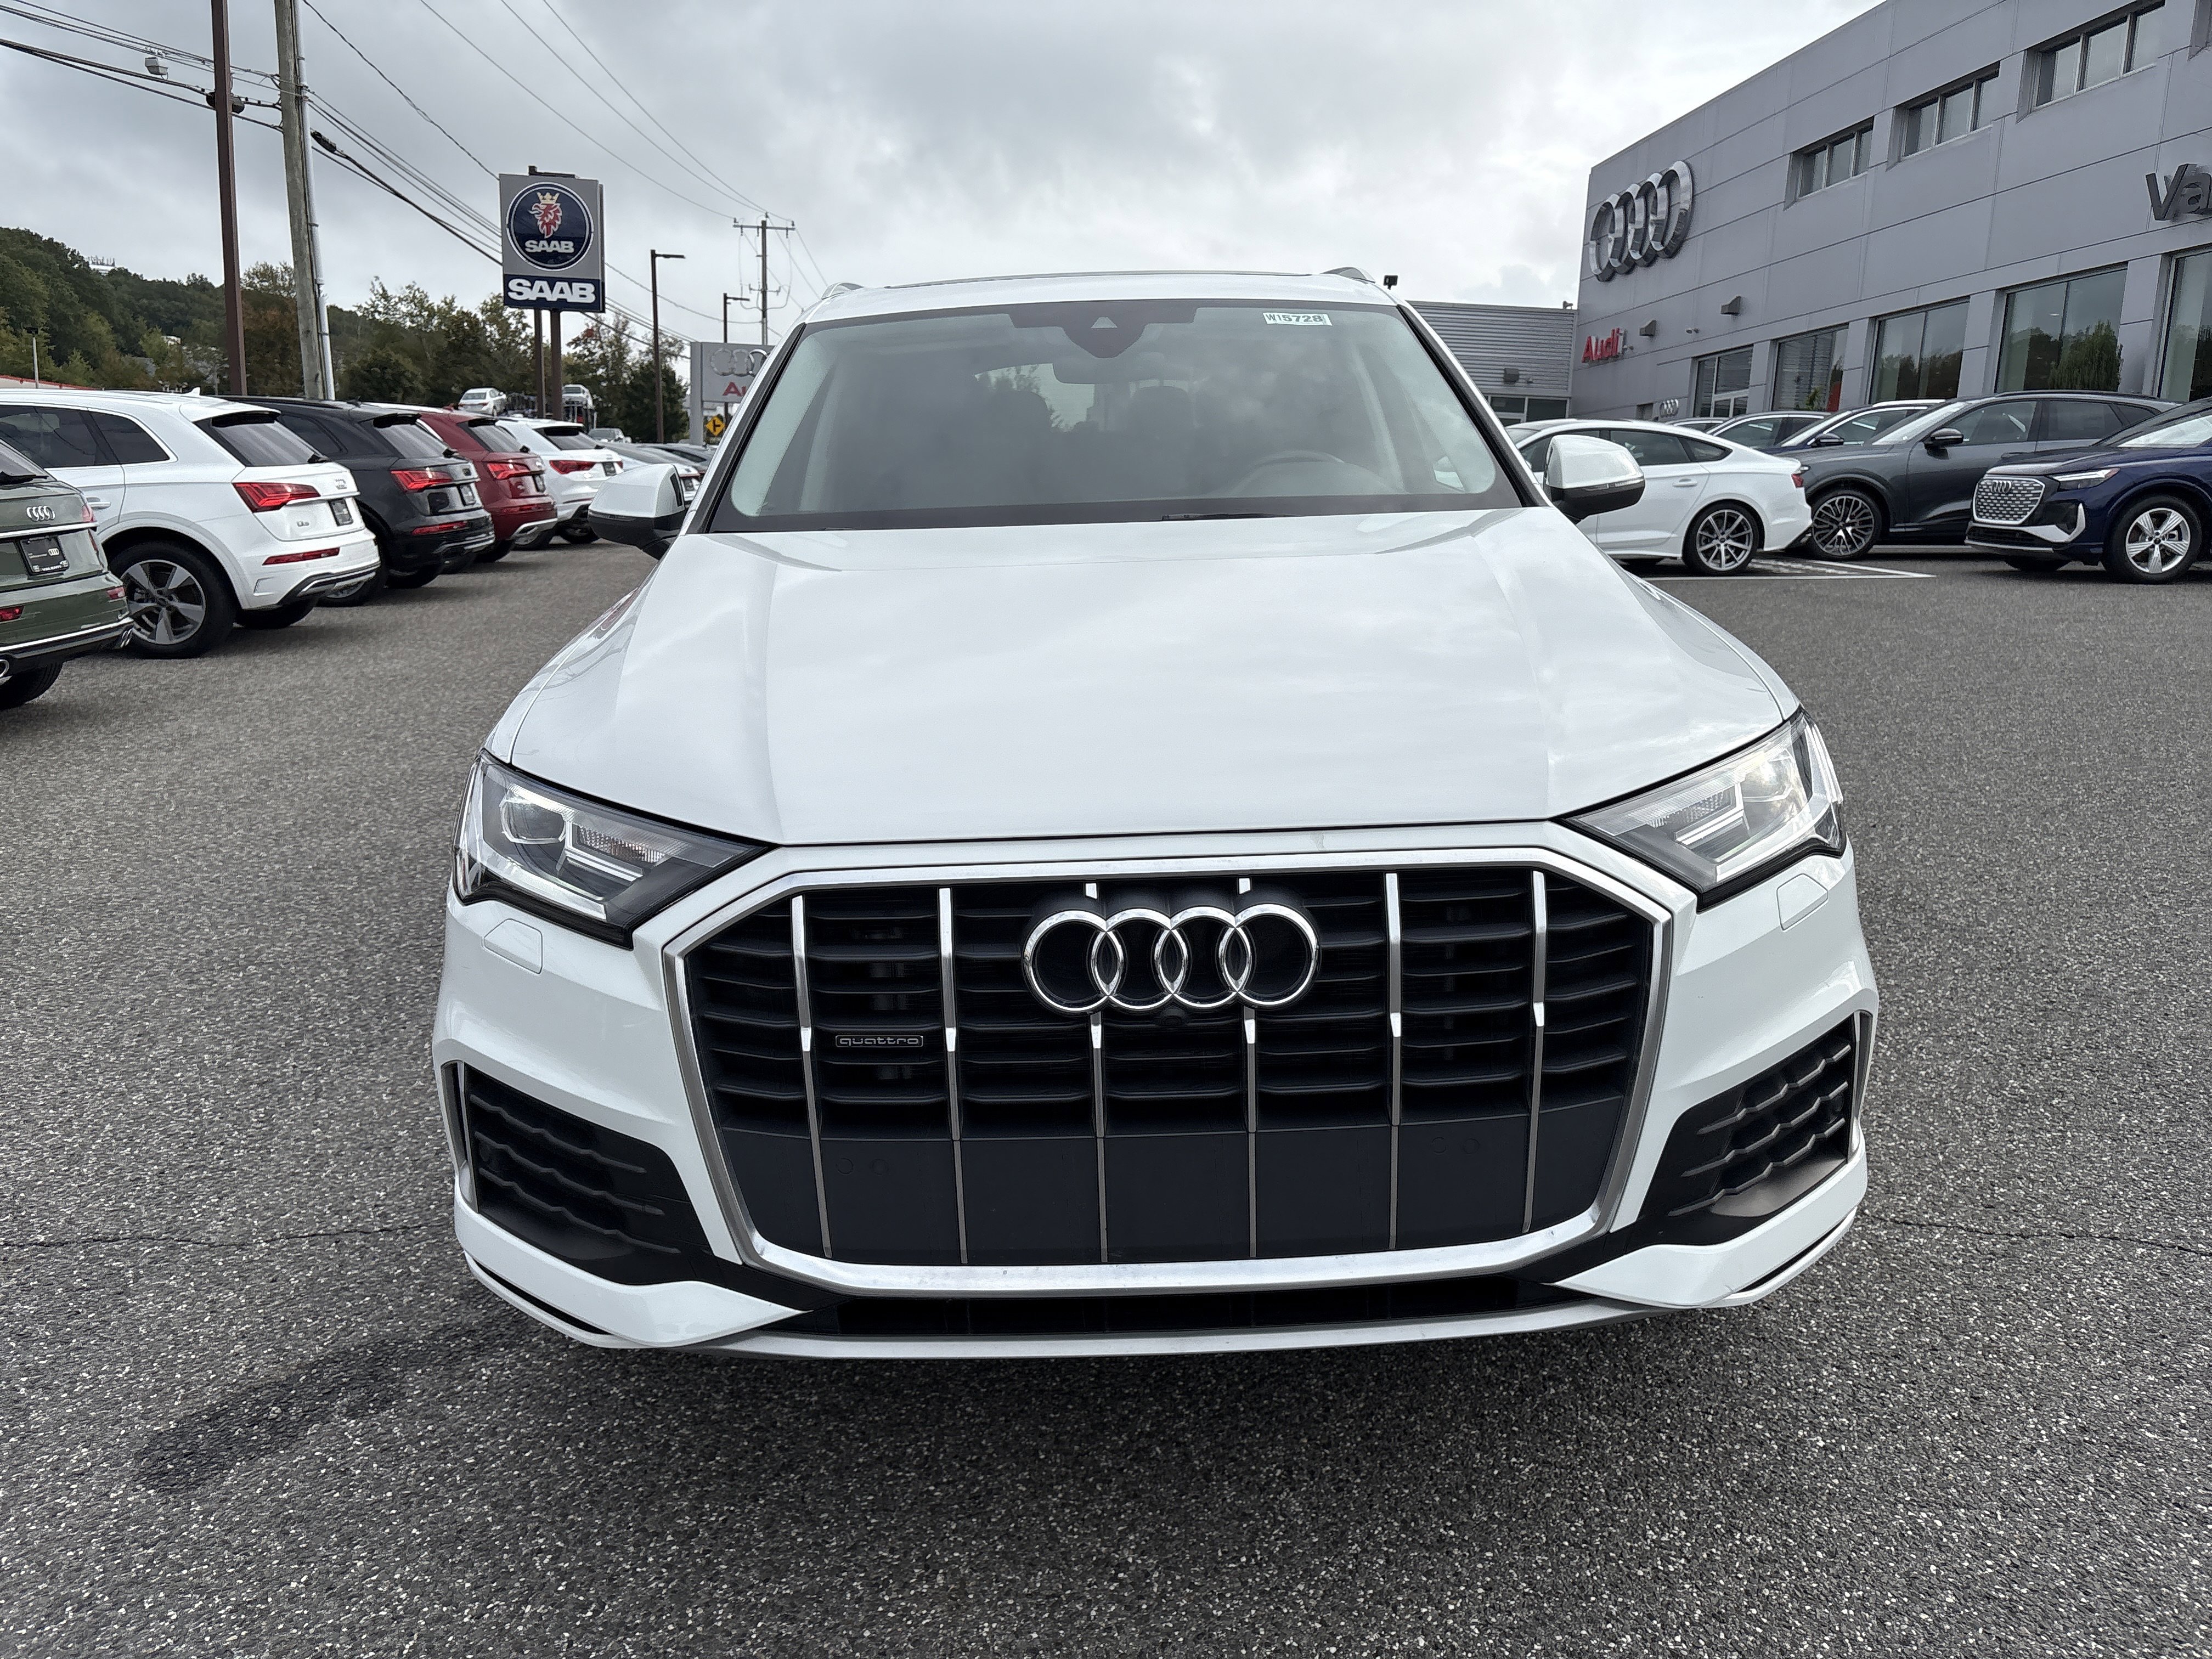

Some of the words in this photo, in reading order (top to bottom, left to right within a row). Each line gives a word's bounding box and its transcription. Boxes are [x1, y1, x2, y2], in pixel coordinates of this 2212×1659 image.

[524, 240, 574, 253] SAAB
[507, 278, 596, 303] SAAB
[1582, 327, 1621, 363] Audi
[839, 1037, 919, 1046] quattro
